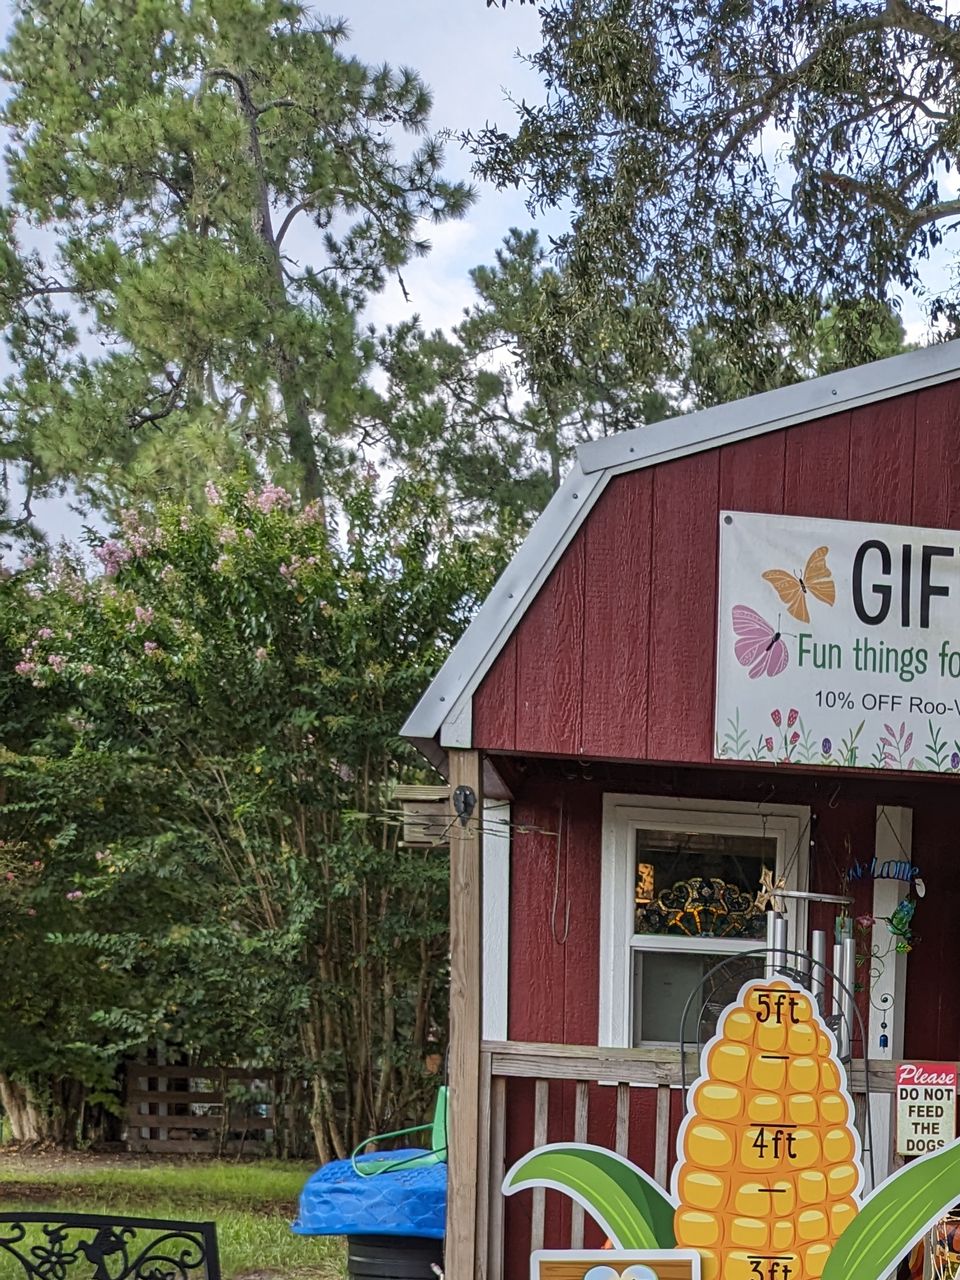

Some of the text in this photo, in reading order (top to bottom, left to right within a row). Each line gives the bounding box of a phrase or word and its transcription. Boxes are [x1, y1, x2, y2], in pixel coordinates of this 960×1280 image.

[798, 633, 842, 670] Fun
[853, 637, 928, 682] things
[815, 690, 855, 710] 10%
[861, 693, 903, 712] OFF
[756, 994, 800, 1025] 5ft
[899, 1064, 955, 1084] Please
[900, 1087, 954, 1101] DO NOT
[908, 1105, 944, 1118] FEED
[911, 1122, 940, 1135] THE
[752, 1127, 797, 1159] 4ft
[906, 1139, 945, 1152] DOGS
